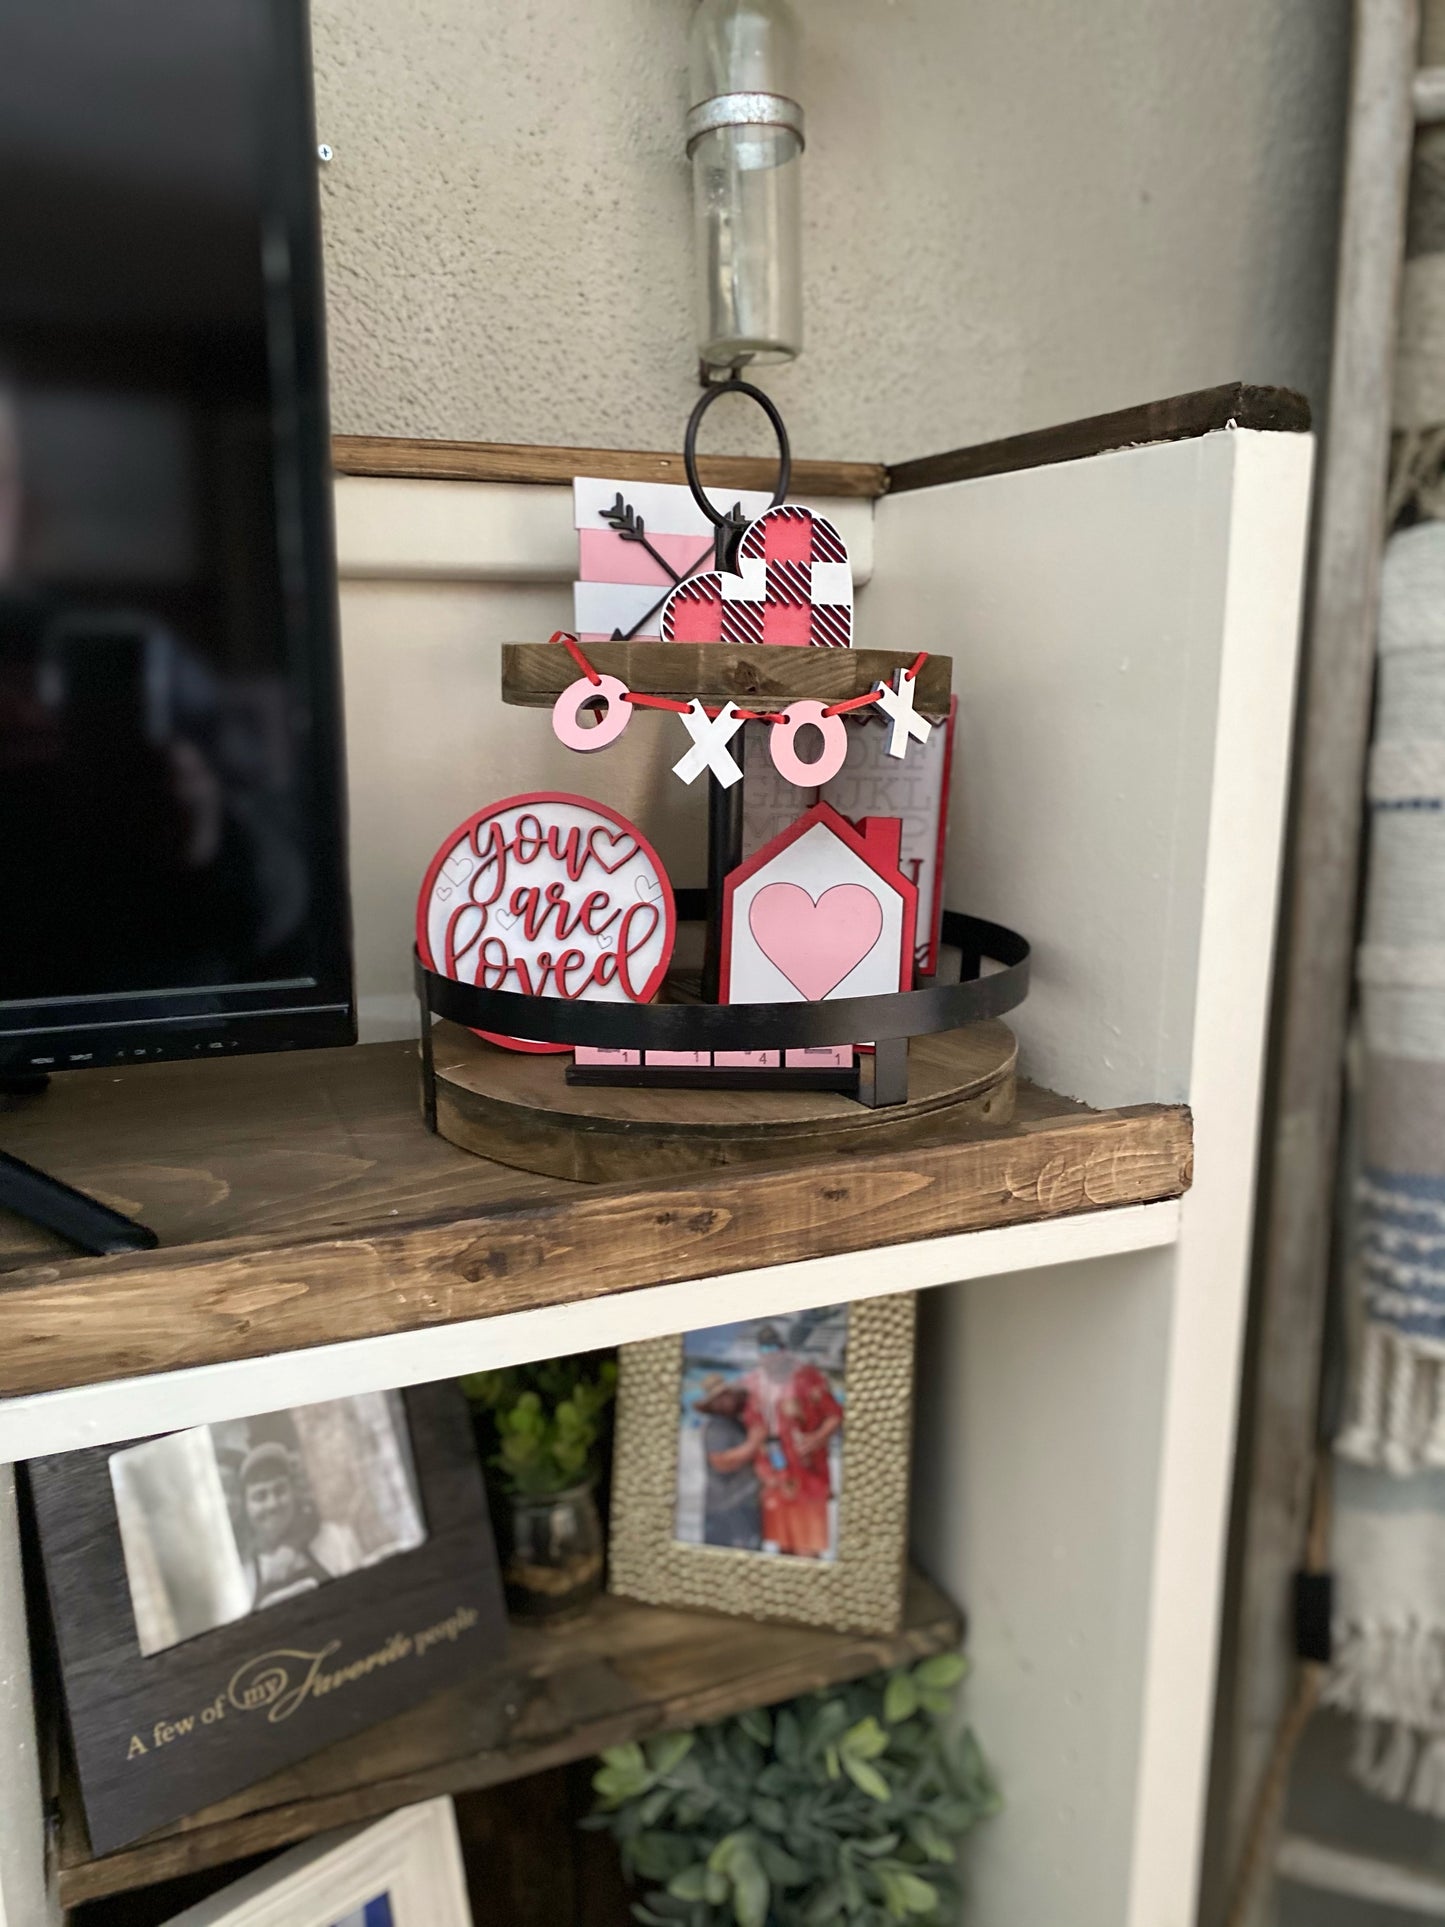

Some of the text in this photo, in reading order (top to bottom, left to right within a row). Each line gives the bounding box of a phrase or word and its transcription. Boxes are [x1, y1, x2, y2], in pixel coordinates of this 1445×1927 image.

[467, 813, 591, 906] you
[445, 901, 659, 1003] loved
[509, 881, 623, 942] are
[127, 1735, 149, 1760] A
[153, 1721, 195, 1748] few
[201, 1694, 226, 1724] of
[244, 1677, 278, 1705] my
